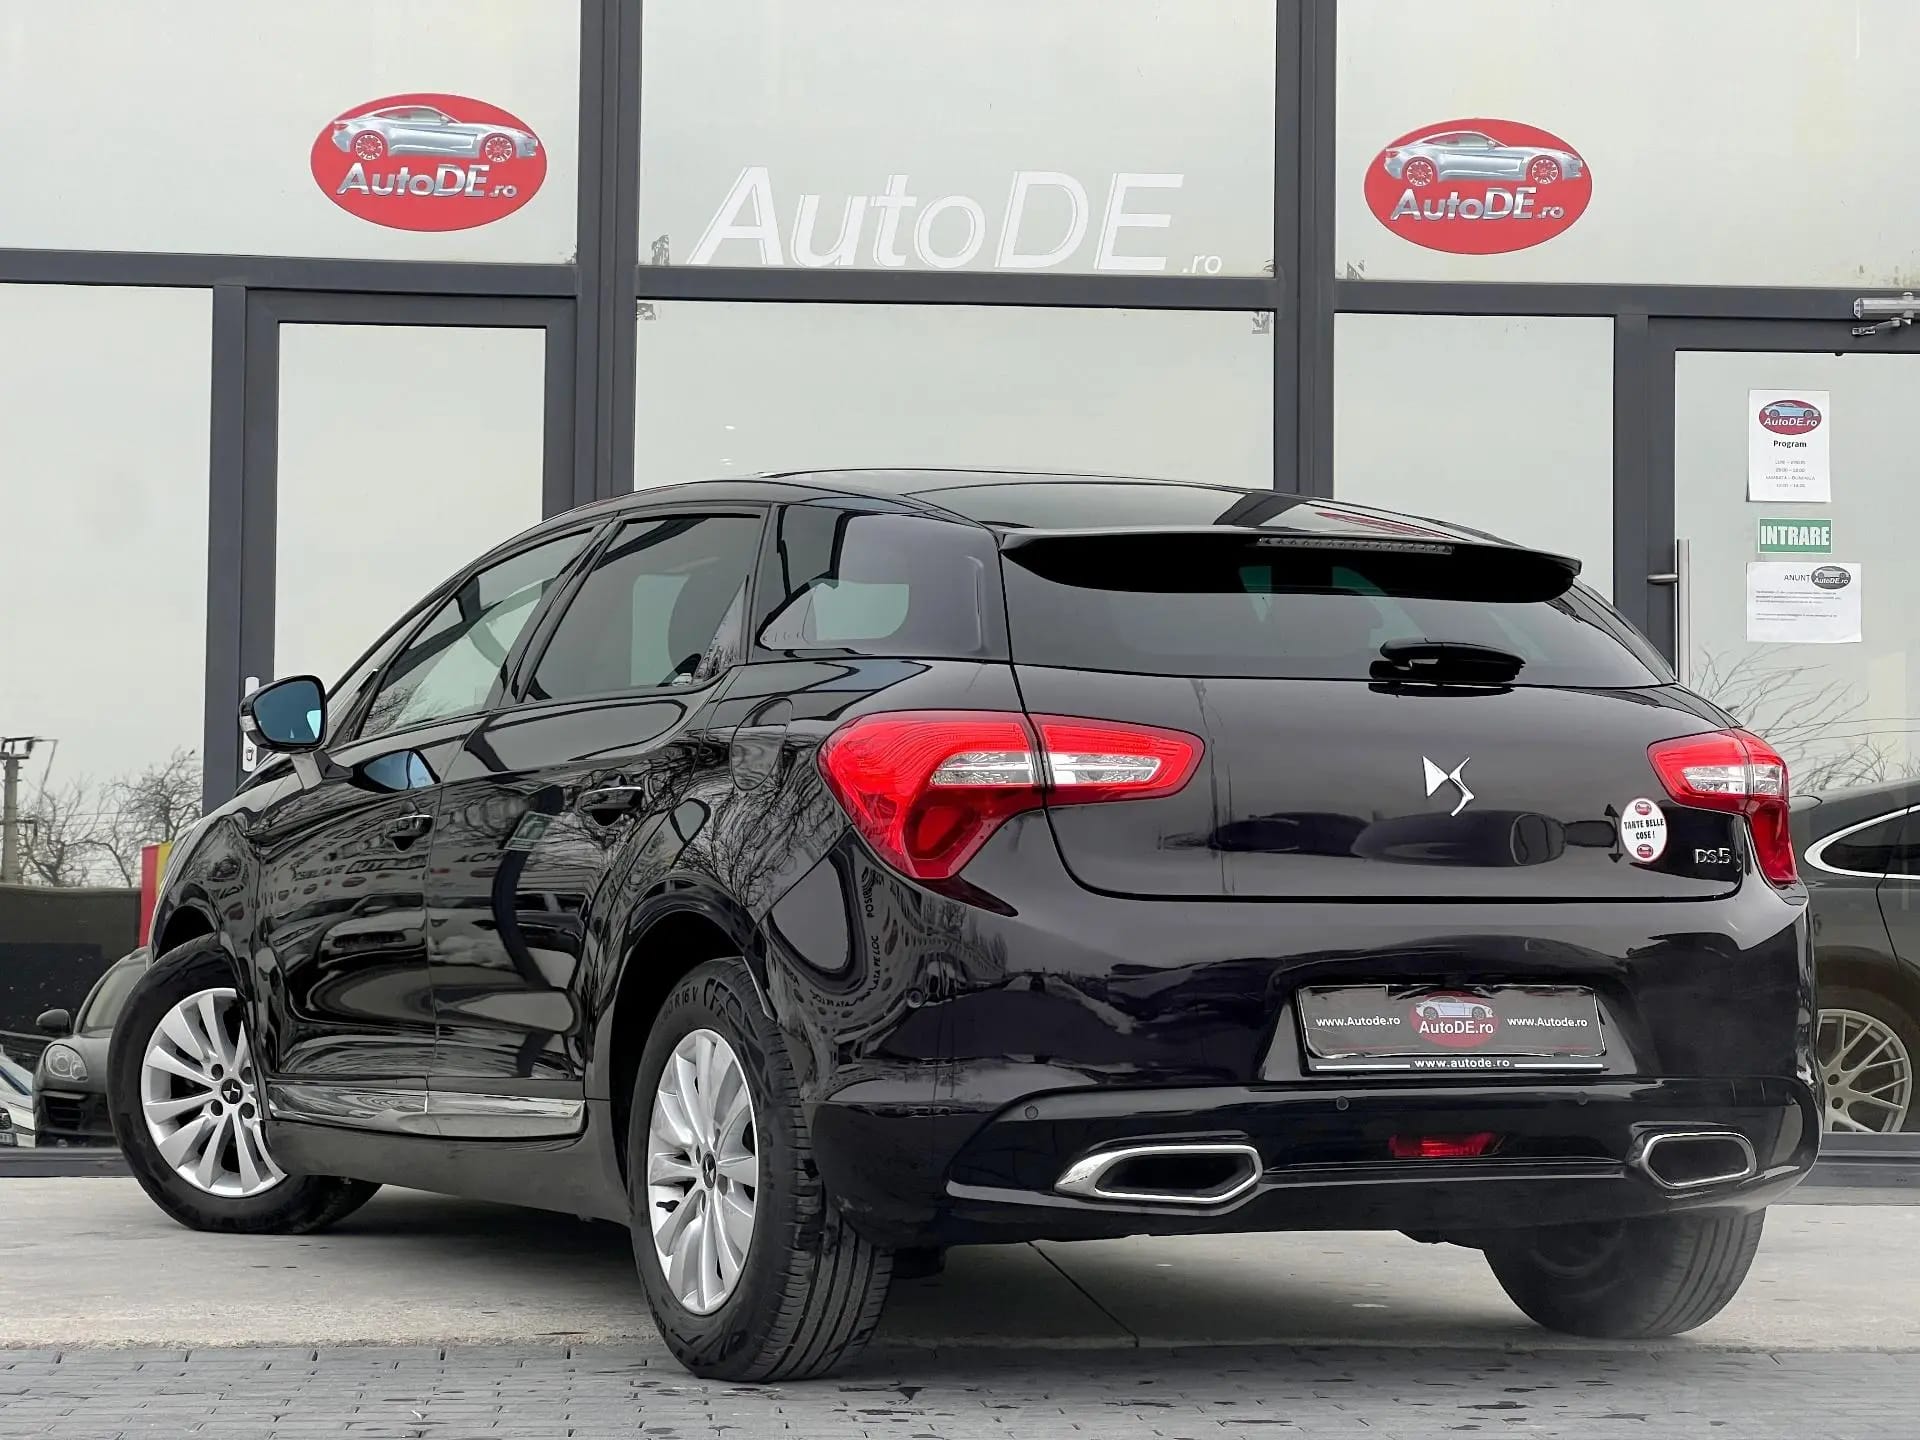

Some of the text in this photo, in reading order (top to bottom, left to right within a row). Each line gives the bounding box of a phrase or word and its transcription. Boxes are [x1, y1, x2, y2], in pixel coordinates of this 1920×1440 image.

[1763, 416, 1818, 427] AutoDE.ro
[1773, 439, 1807, 449] Program
[1760, 525, 1830, 546] INTRARE
[1624, 818, 1664, 830] TANTE BELLE
[1315, 1015, 1401, 1027] www.Autode.ro
[1507, 1016, 1588, 1028] www.Autode.ro
[1418, 1020, 1494, 1035] AutoDE.ro
[1414, 1057, 1510, 1069] www.autode.ro
